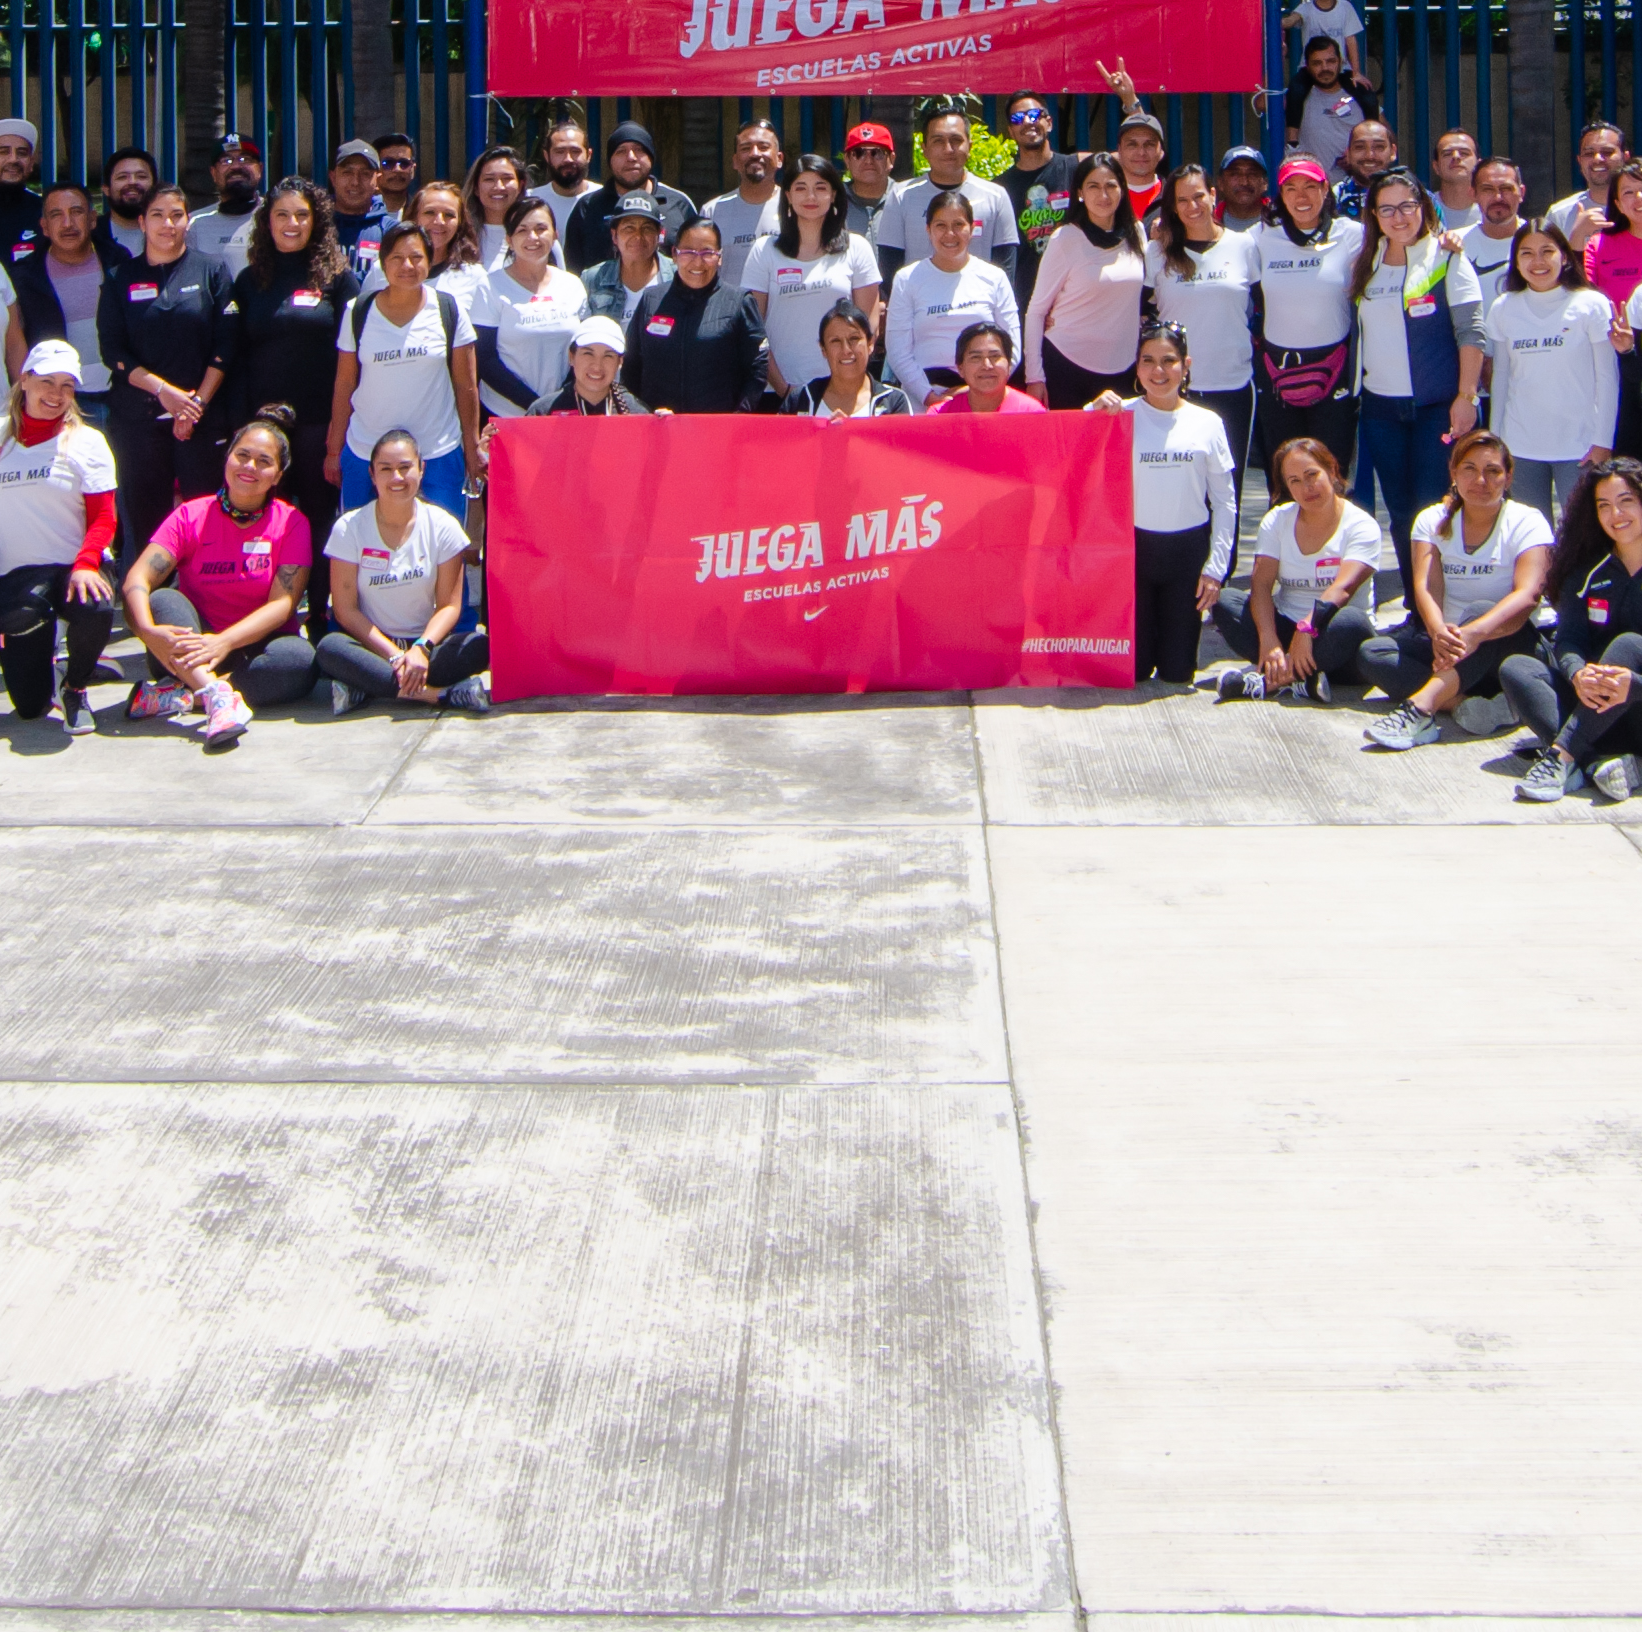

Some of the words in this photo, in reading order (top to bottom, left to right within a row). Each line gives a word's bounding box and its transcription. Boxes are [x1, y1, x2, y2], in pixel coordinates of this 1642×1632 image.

[757, 51, 881, 87] ESCUELAS
[890, 34, 992, 67] ACTIVAS
[373, 349, 401, 363] JUEGA
[690, 521, 824, 583] JUEGA
[846, 493, 943, 561] MÁS
[369, 573, 398, 586] JUEGA
[743, 580, 822, 602] ESCUELAS
[826, 566, 890, 591] ACTIVAS
[1021, 637, 1130, 655] #HECHOPARAJUGAR
